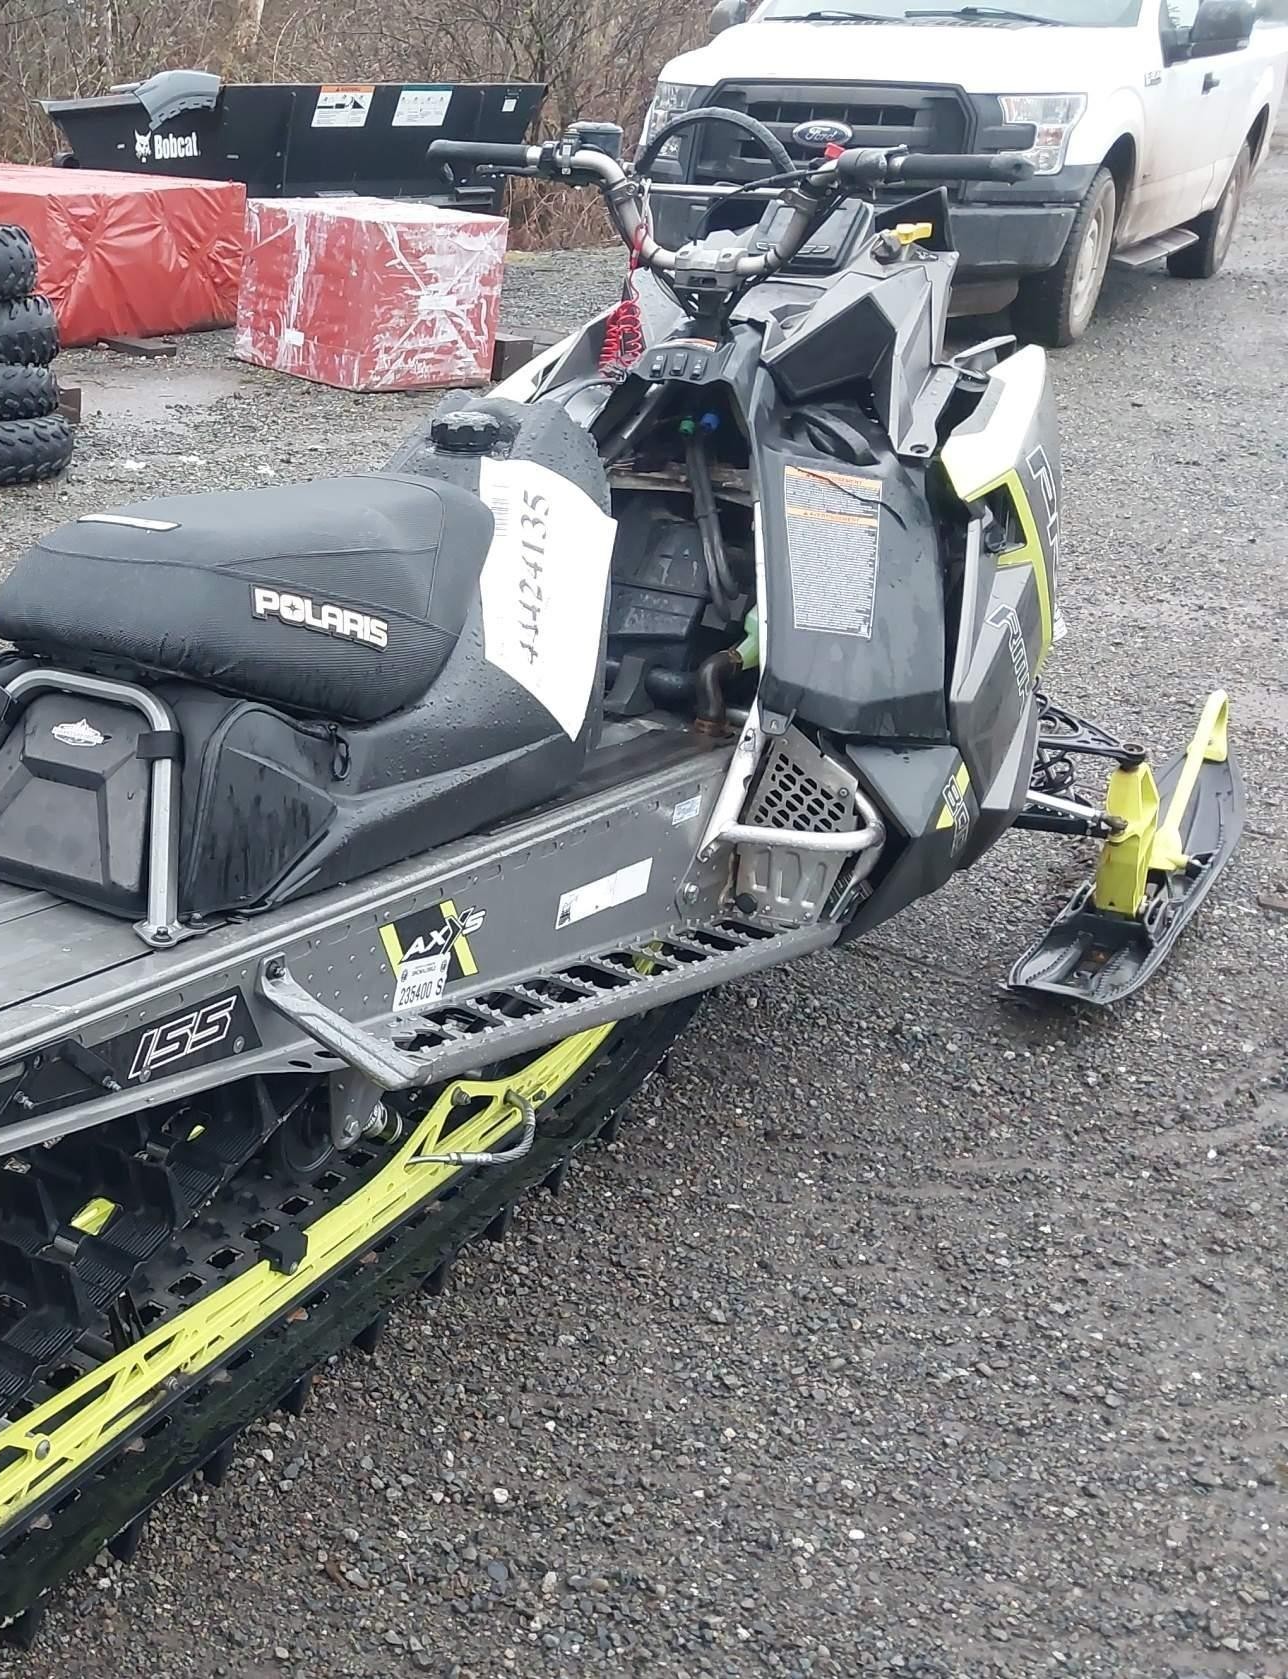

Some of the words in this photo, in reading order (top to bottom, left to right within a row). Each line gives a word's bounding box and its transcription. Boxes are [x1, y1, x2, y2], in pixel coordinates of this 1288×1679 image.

[153, 131, 199, 160] Bobcat
[804, 126, 838, 141] Ford
[253, 587, 390, 649] POLARIS
[398, 980, 433, 1006] 235400
[435, 977, 444, 996] S
[127, 994, 238, 1080] 155
